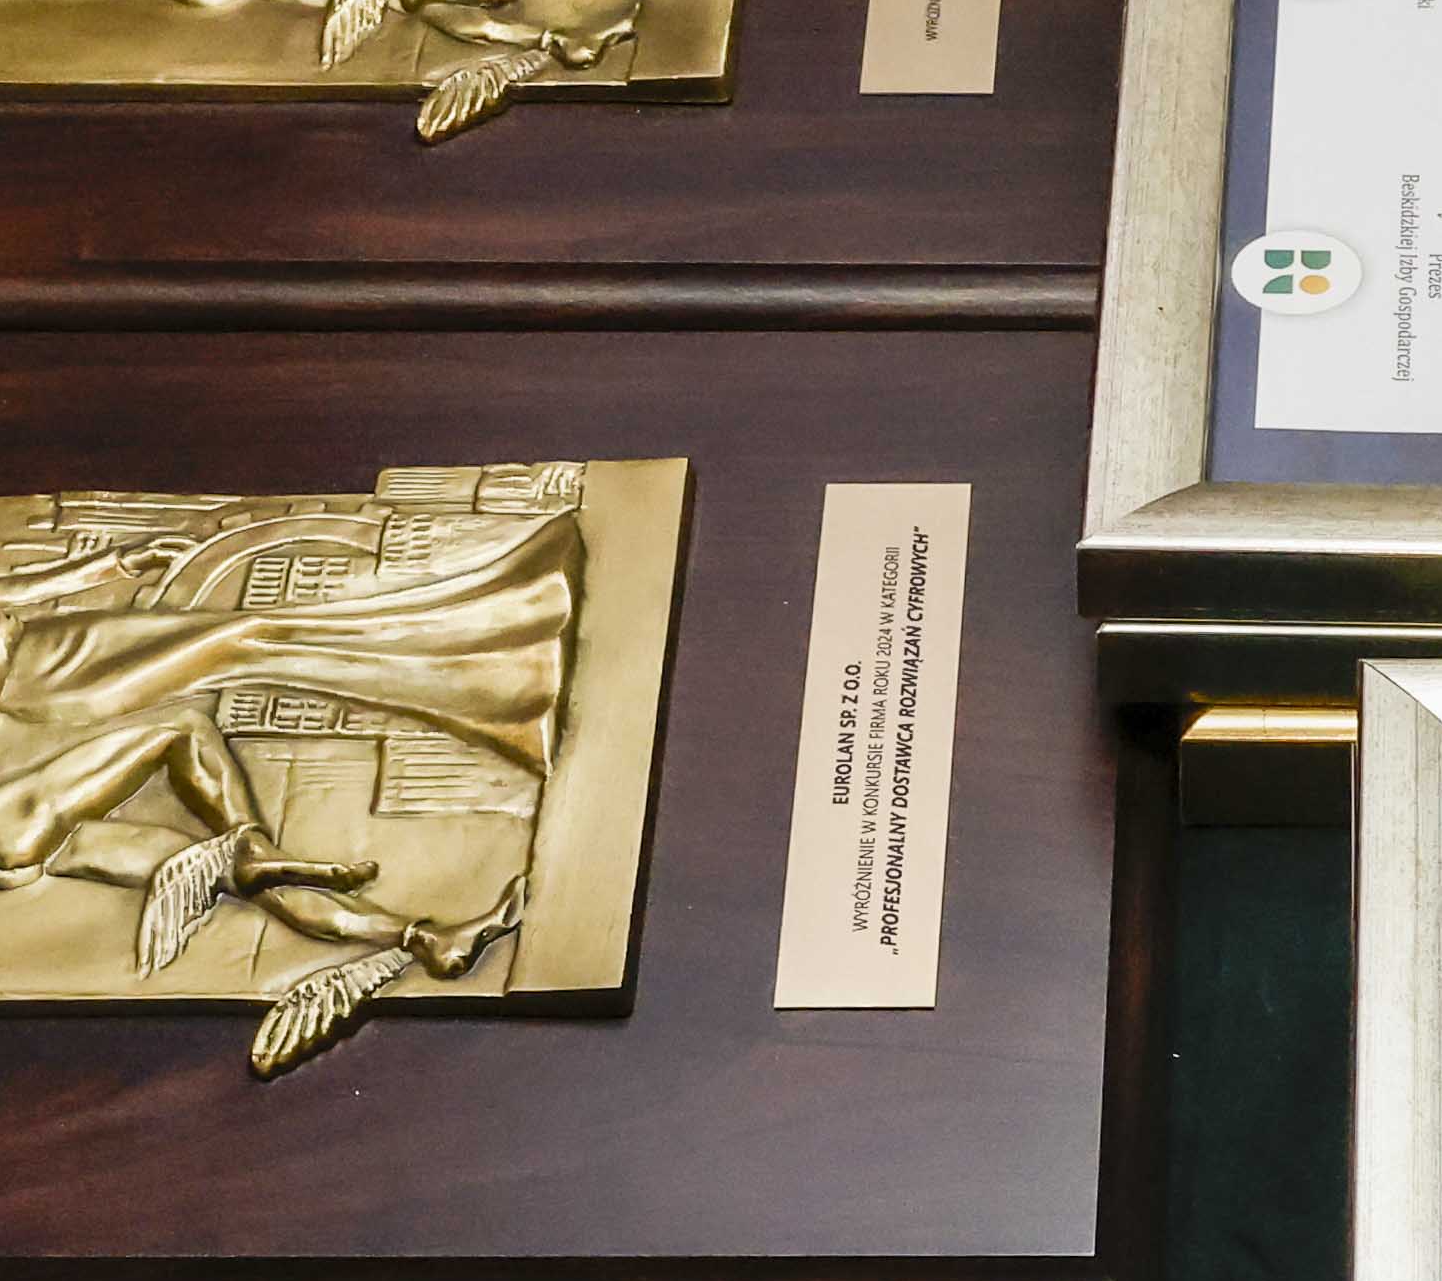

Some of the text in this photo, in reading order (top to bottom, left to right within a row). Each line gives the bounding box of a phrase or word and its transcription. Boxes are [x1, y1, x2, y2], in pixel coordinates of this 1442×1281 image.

[1391, 174, 1421, 382] Beskidzkiej Izby Gospodarczej
[832, 661, 862, 805] EUROLAN SP. Z O.O.
[851, 546, 900, 932] WYRÓŻNIENIE W KONKURSIE FIRMA ROKU 2024 W KATEGORII
[898, 625, 924, 718] ROZWIĄZAŃ
[891, 723, 915, 809] DOSTAWCA
